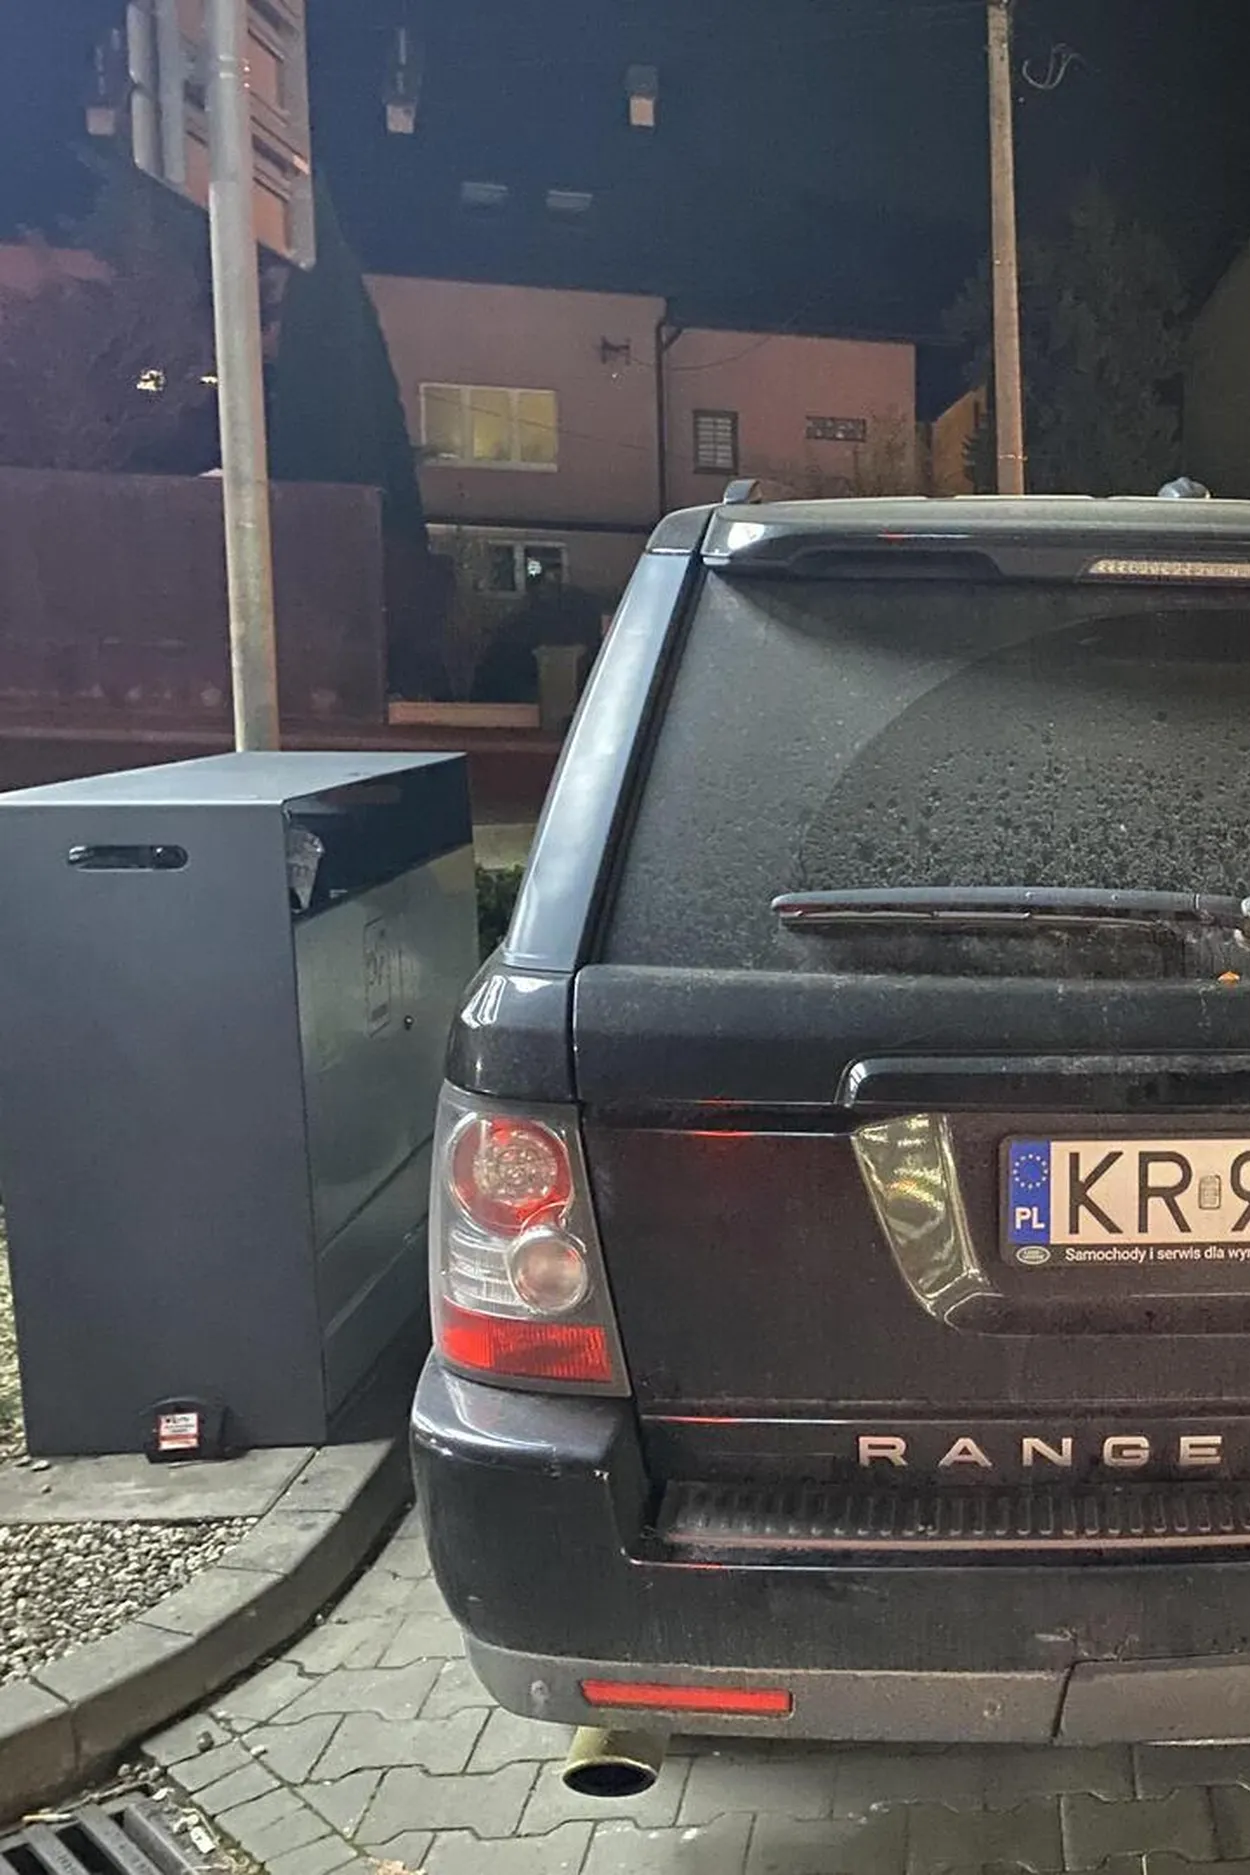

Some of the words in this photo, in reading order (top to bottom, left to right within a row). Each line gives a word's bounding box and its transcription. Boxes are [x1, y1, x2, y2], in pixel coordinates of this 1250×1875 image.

[1068, 1150, 1194, 1236] KR
[1014, 1206, 1045, 1230] PL
[1065, 1247, 1147, 1263] Samochody
[1157, 1246, 1201, 1261] serwis
[1204, 1246, 1225, 1259] dla
[857, 1434, 1223, 1468] RANGE
